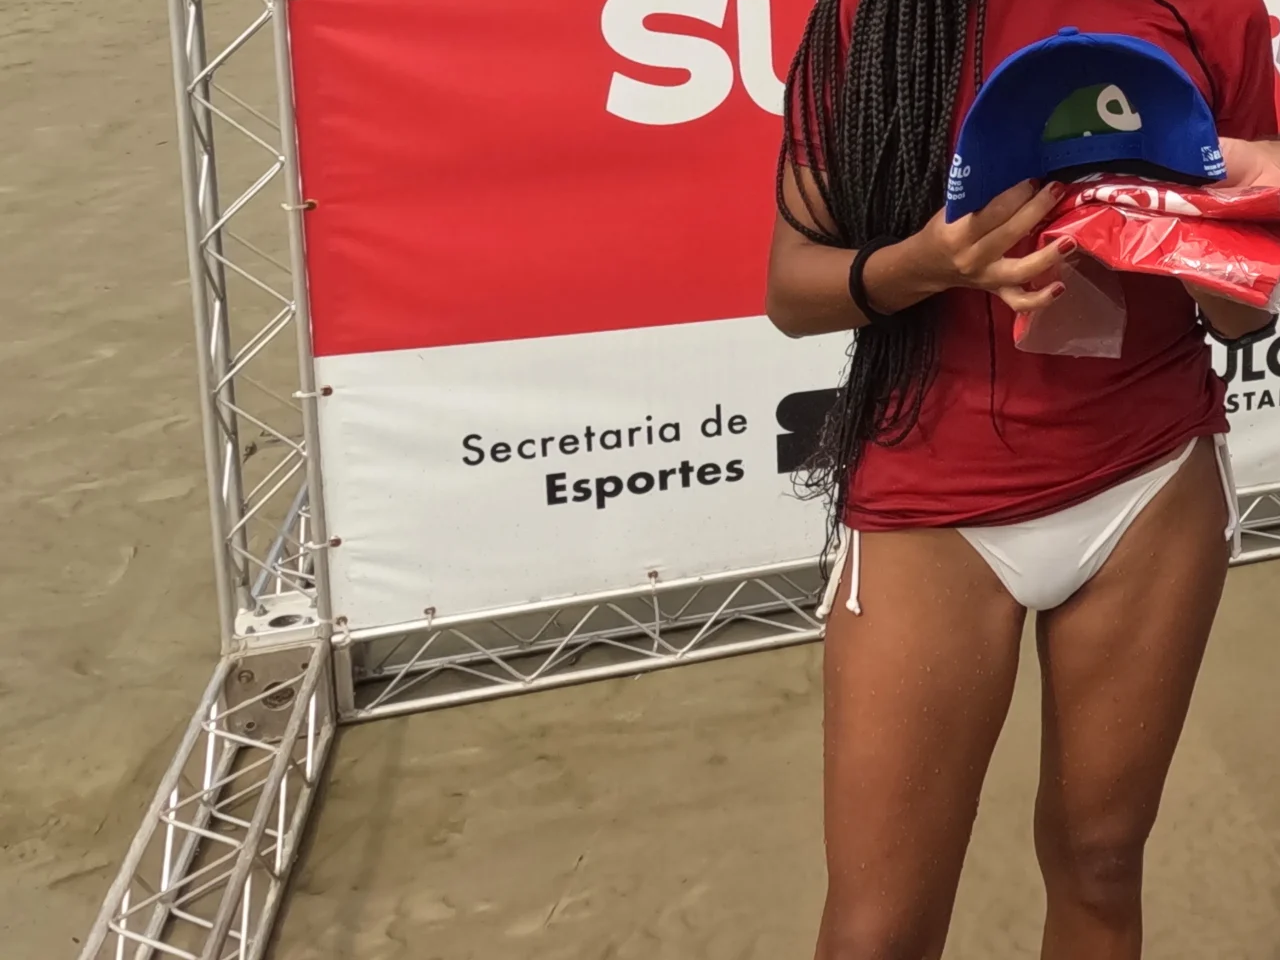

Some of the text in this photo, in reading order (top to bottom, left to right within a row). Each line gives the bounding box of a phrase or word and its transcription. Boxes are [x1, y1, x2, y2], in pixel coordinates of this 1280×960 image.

[462, 404, 748, 466] Secretaria de
[545, 458, 745, 510] Esportes
